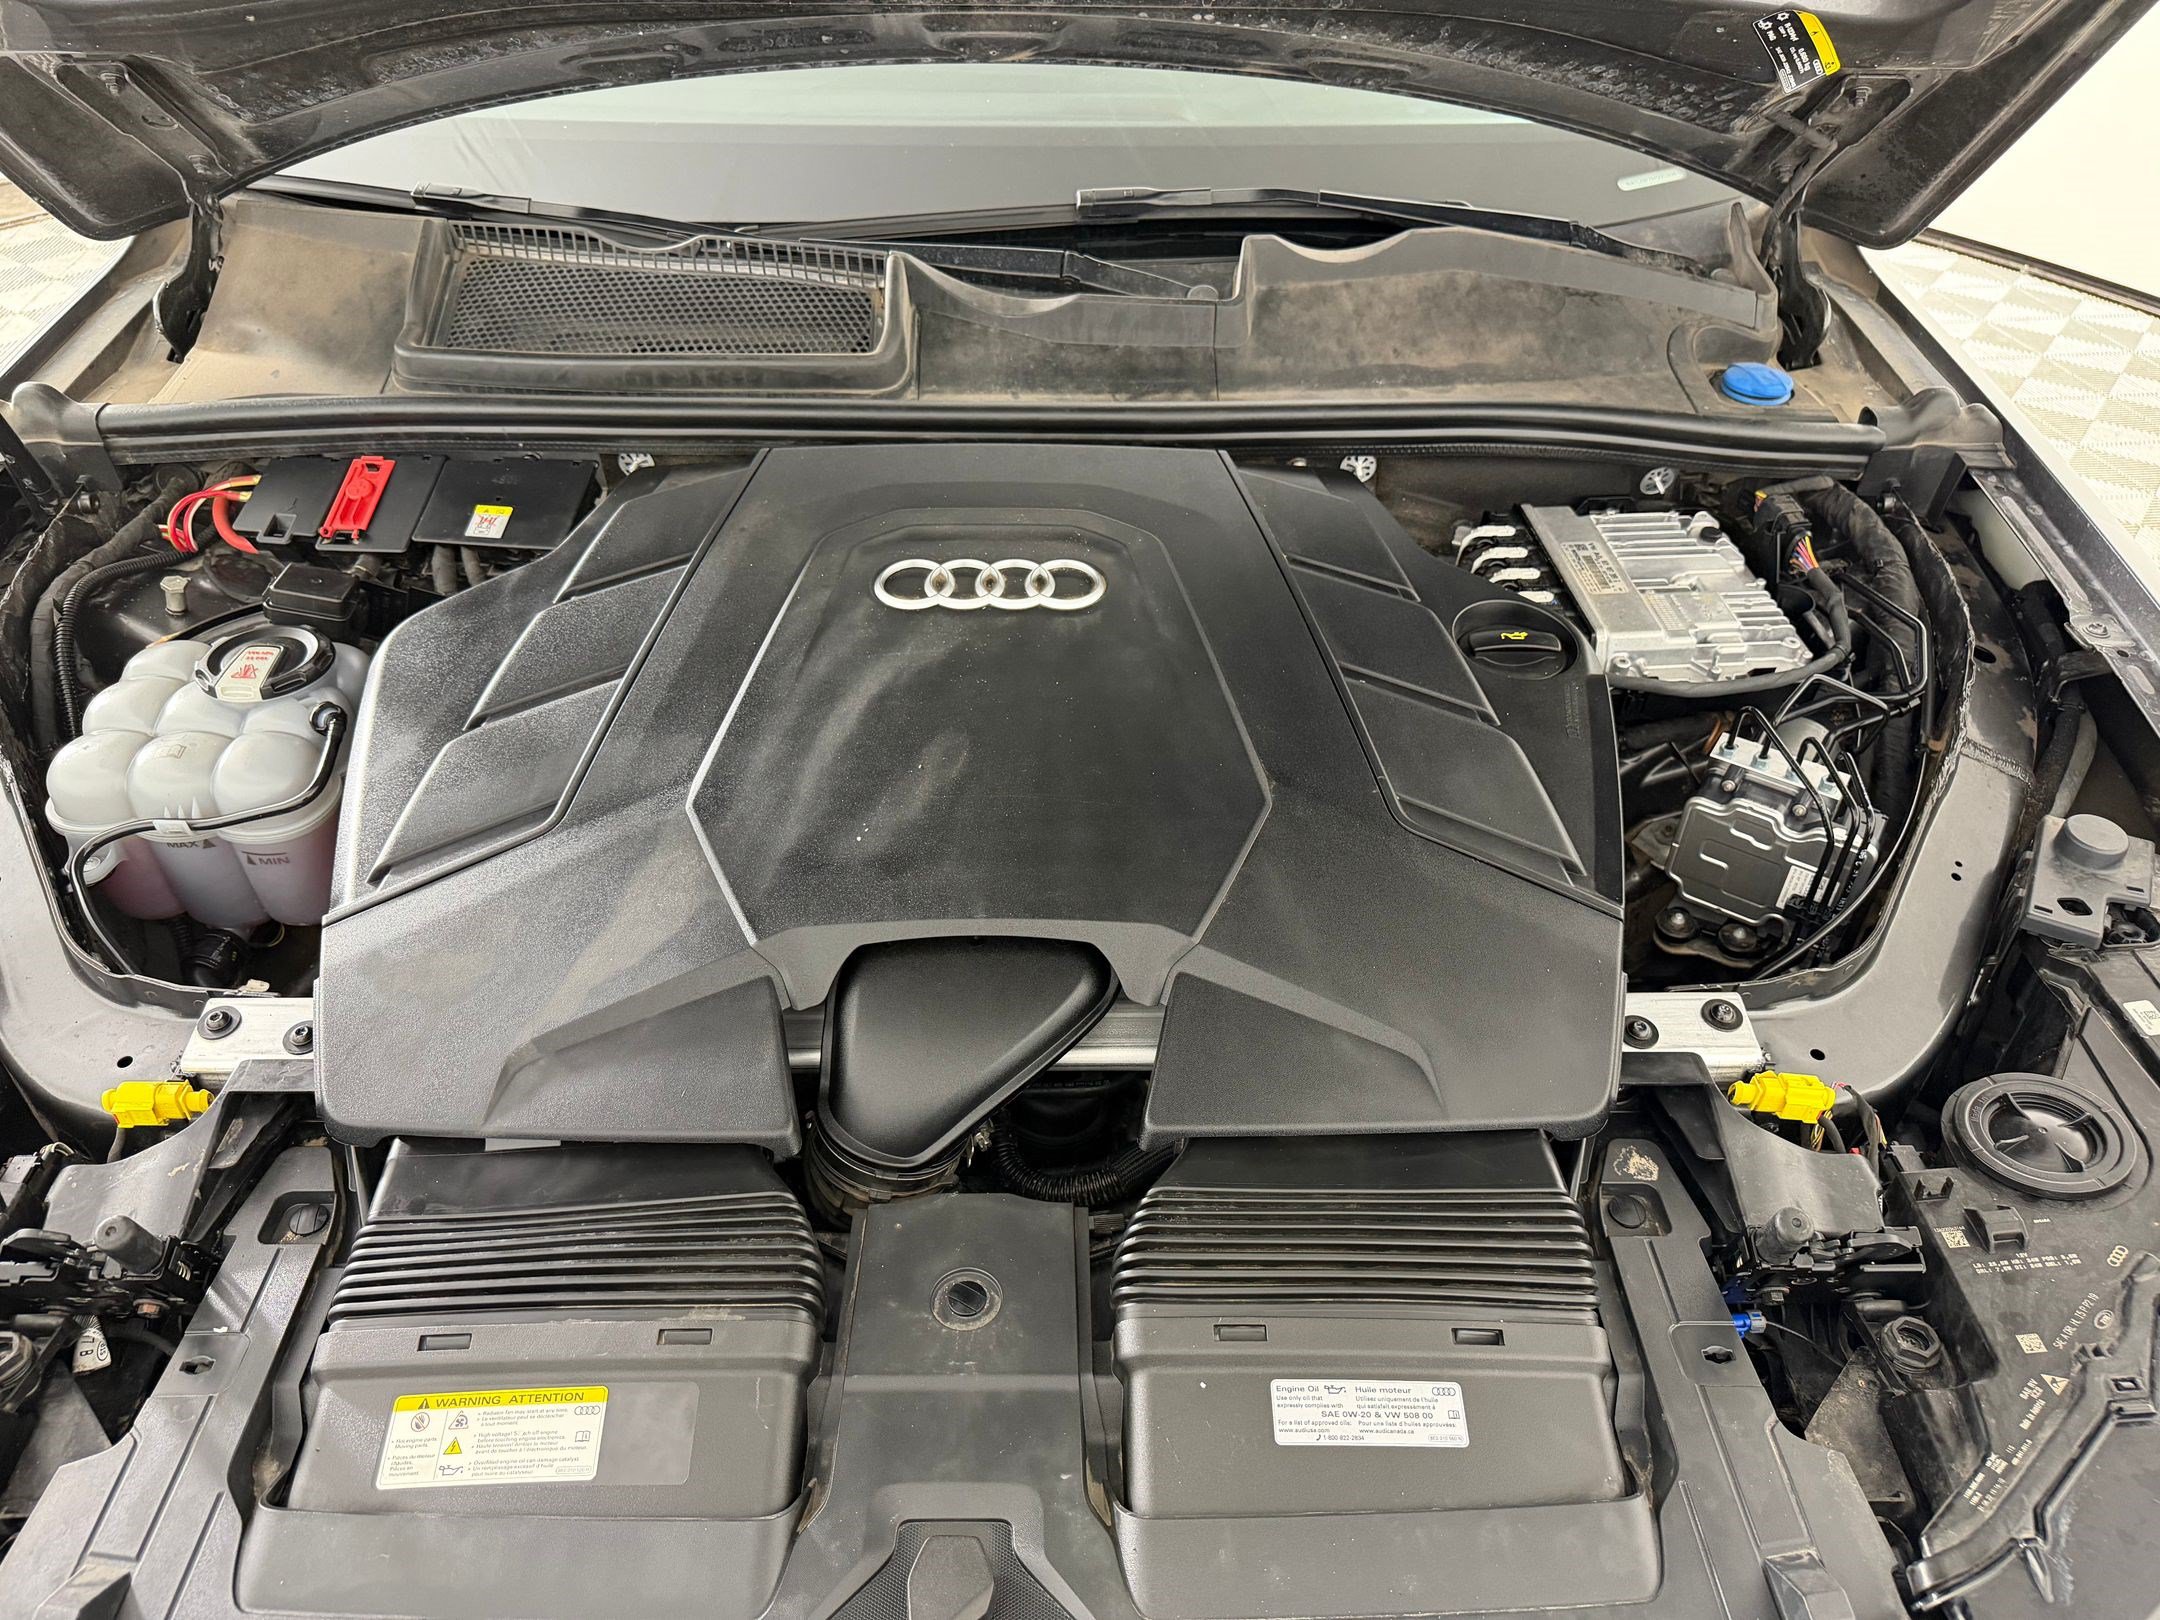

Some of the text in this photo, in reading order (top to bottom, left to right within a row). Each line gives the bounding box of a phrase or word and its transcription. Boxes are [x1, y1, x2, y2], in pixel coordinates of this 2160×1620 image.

[166, 840, 199, 848] MAX
[258, 856, 290, 865] MIN
[436, 1392, 584, 1407] WARNING ATTENTION
